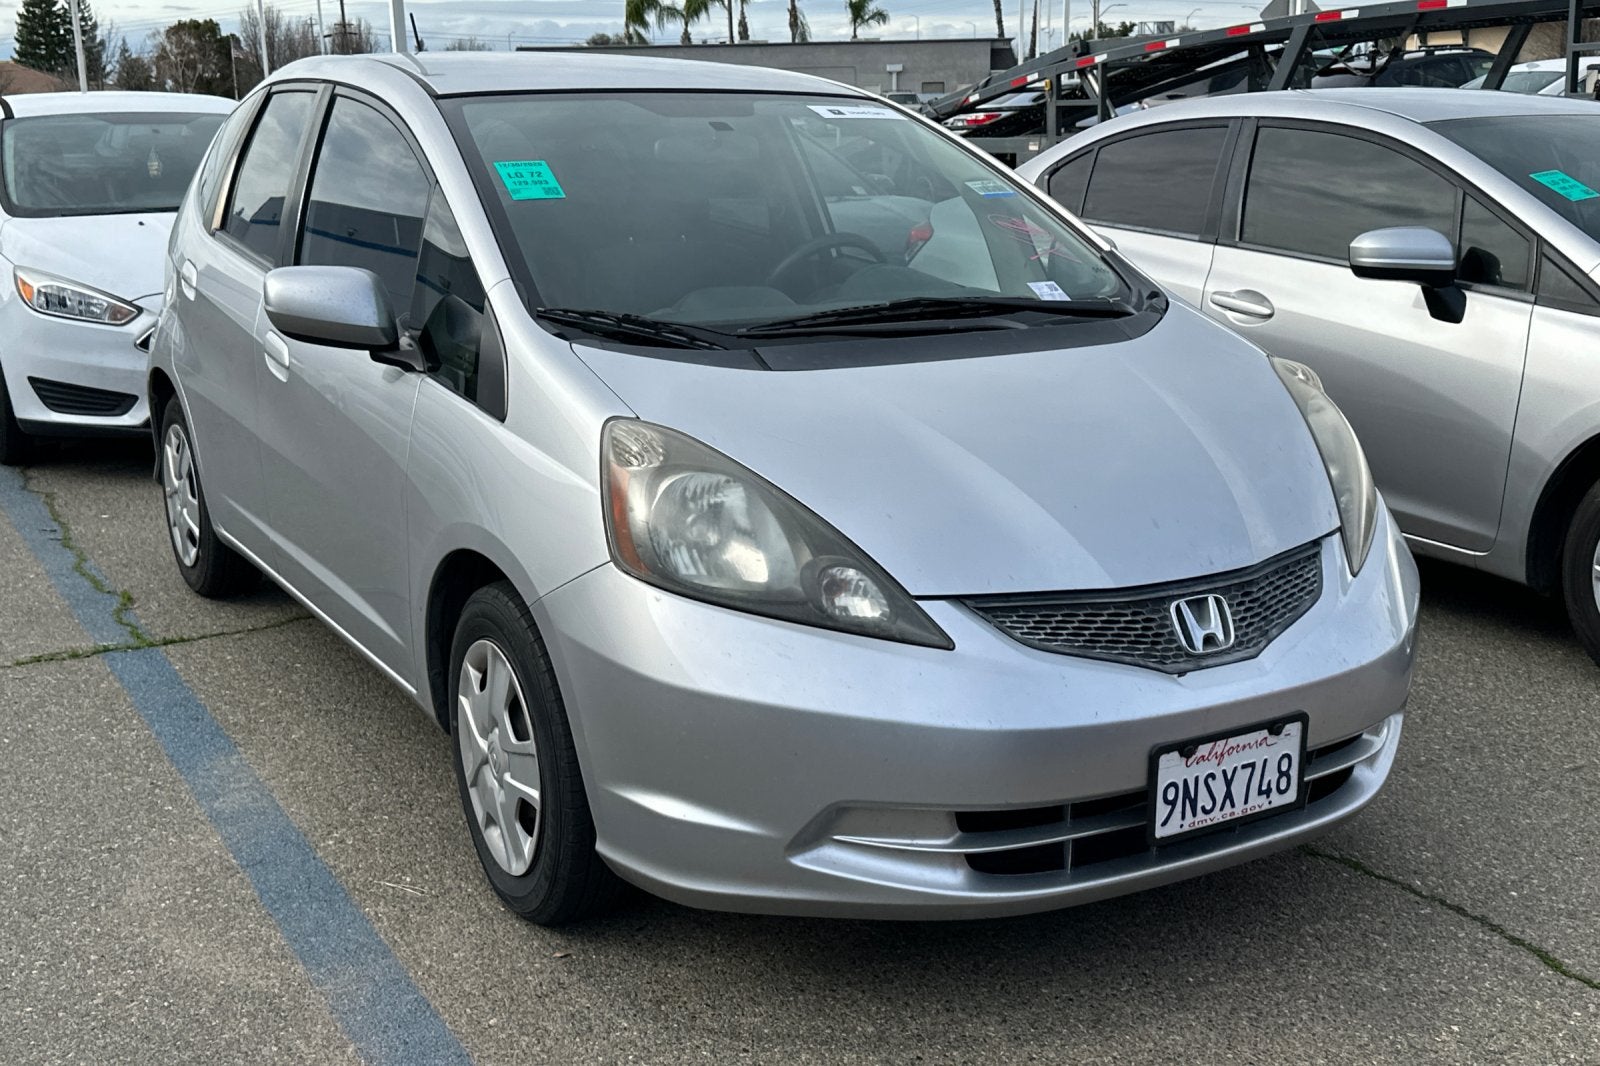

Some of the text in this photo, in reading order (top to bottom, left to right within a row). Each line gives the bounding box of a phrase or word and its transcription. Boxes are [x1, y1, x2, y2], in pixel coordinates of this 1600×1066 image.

[507, 170, 543, 179] LQ 72
[1184, 736, 1277, 768] California
[1160, 752, 1293, 828] 9NSX748
[1188, 802, 1265, 828] dmv.ca.gov
